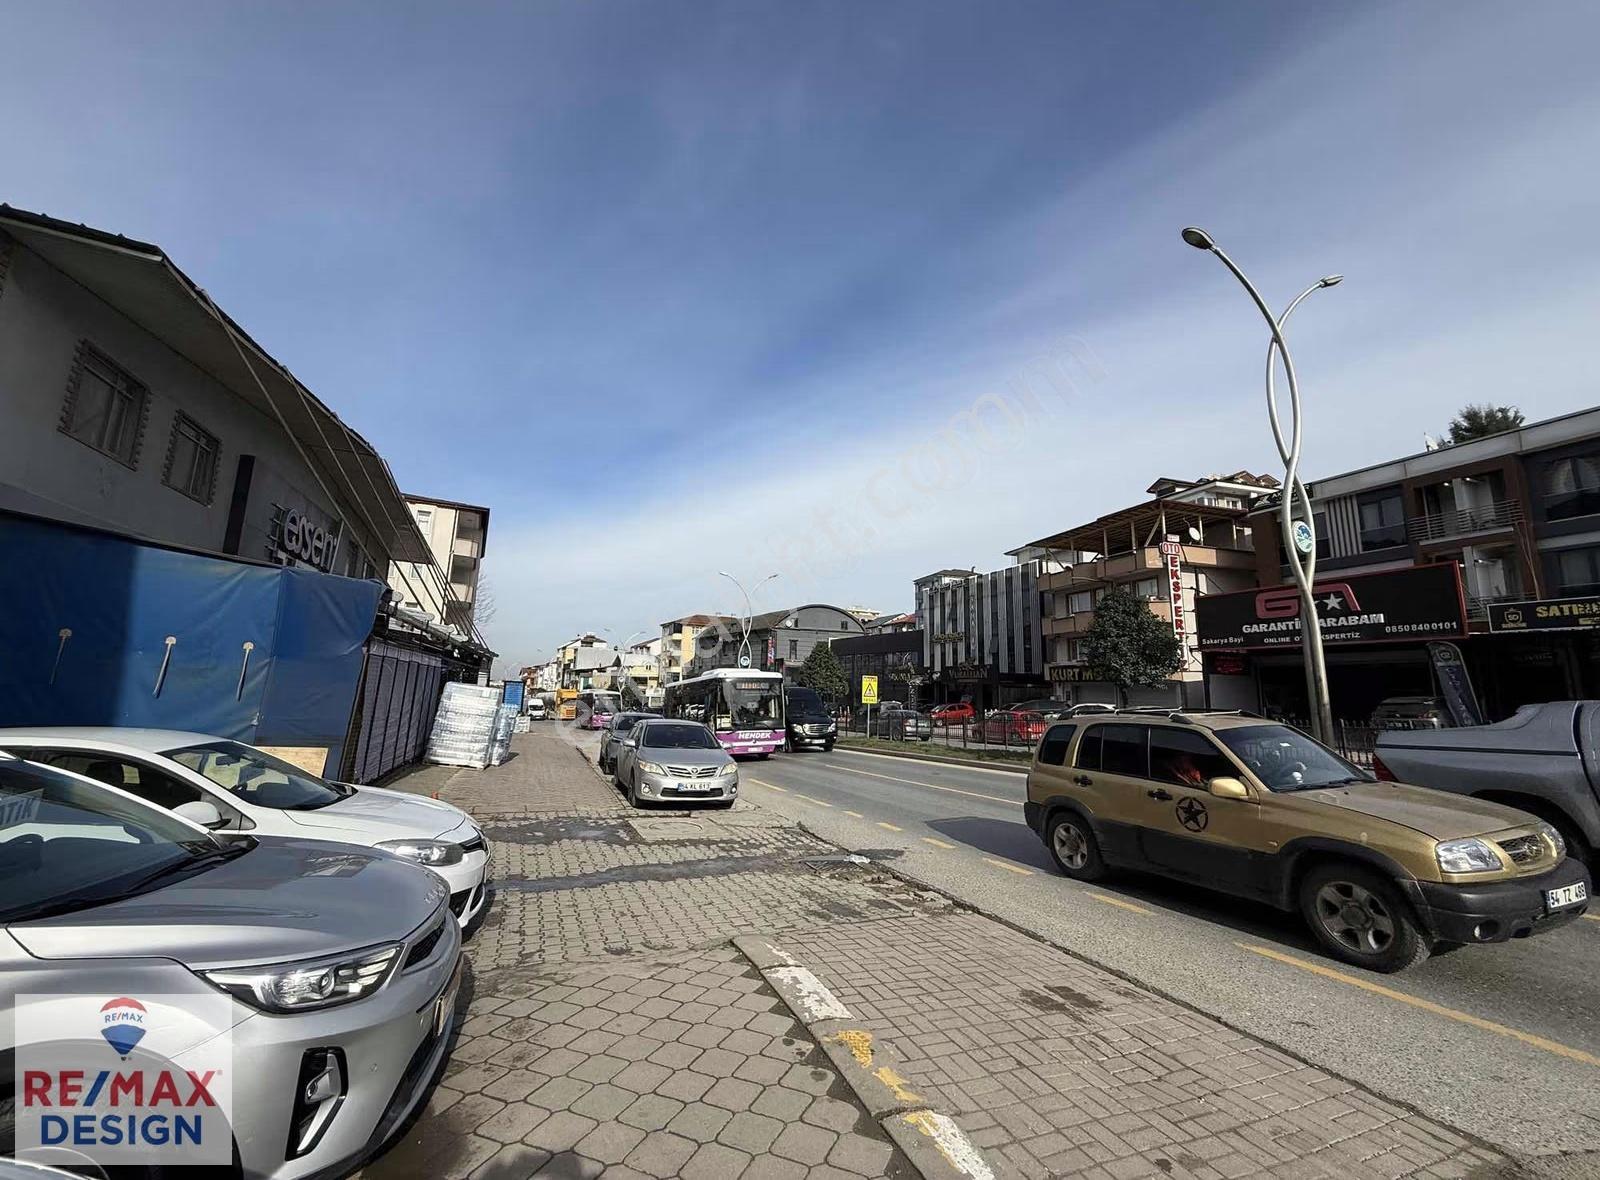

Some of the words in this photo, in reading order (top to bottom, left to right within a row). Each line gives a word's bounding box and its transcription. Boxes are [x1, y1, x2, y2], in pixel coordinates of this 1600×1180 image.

[1163, 542, 1180, 555] OTO
[1385, 625, 1409, 633] 0850
[1411, 623, 1430, 631] 840
[1431, 621, 1457, 630] 0101
[1202, 637, 1228, 645] Sakarya
[1229, 636, 1244, 645] Bayi
[1320, 632, 1360, 641] KSPERTİZ
[1051, 668, 1080, 680] KURT
[1550, 891, 1560, 905] 54
